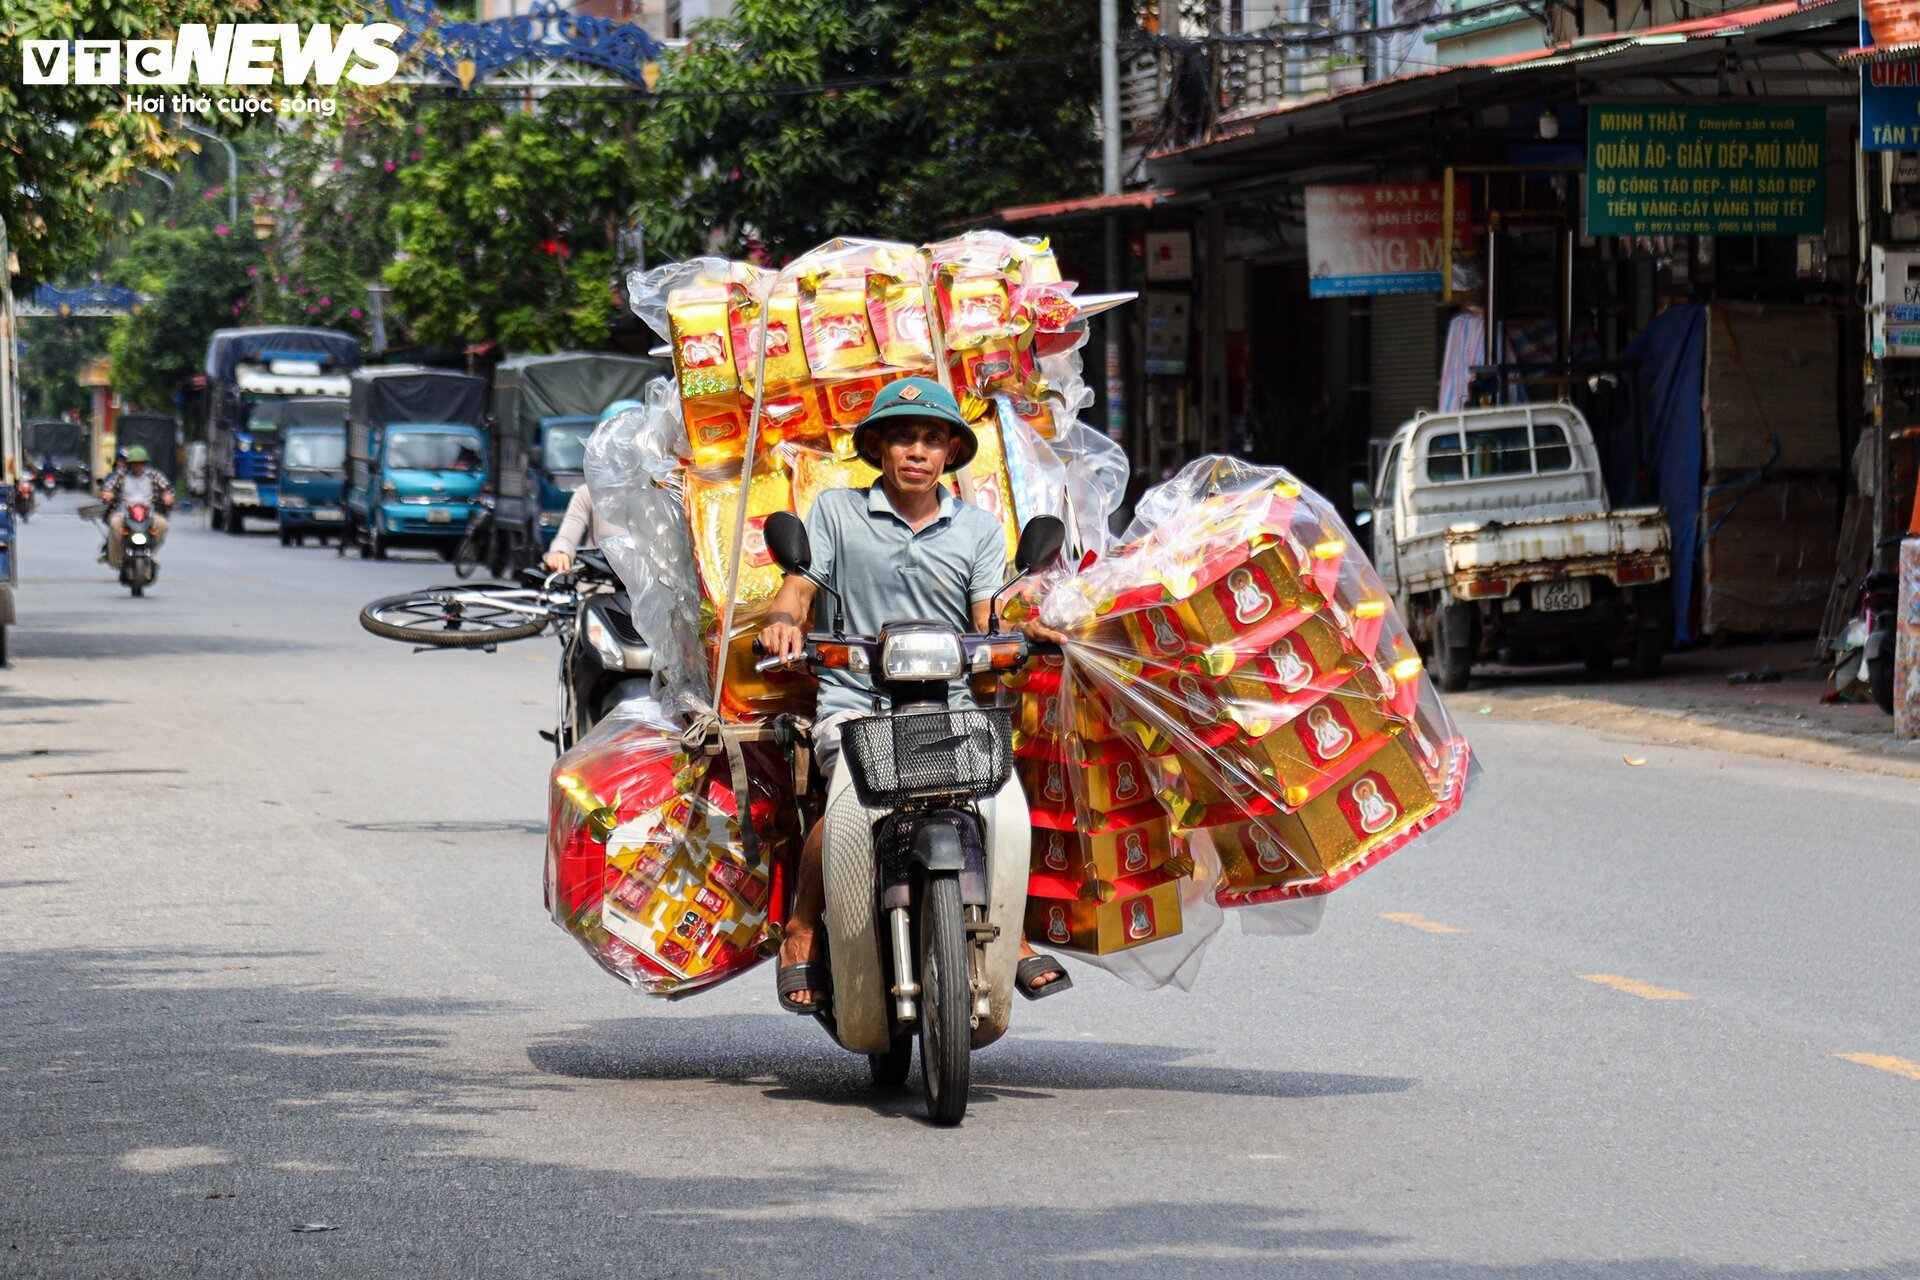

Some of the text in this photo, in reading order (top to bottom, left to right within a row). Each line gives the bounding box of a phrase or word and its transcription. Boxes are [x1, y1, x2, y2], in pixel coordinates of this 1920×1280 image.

[1600, 114, 1643, 131] MINH
[1648, 111, 1687, 135] THẬT
[1872, 123, 1906, 145] TÂN
[1785, 138, 1820, 169] NÓN
[1597, 176, 1617, 198] BỘ
[1620, 176, 1659, 194] CÔNG
[1713, 199, 1750, 217] VÀNG
